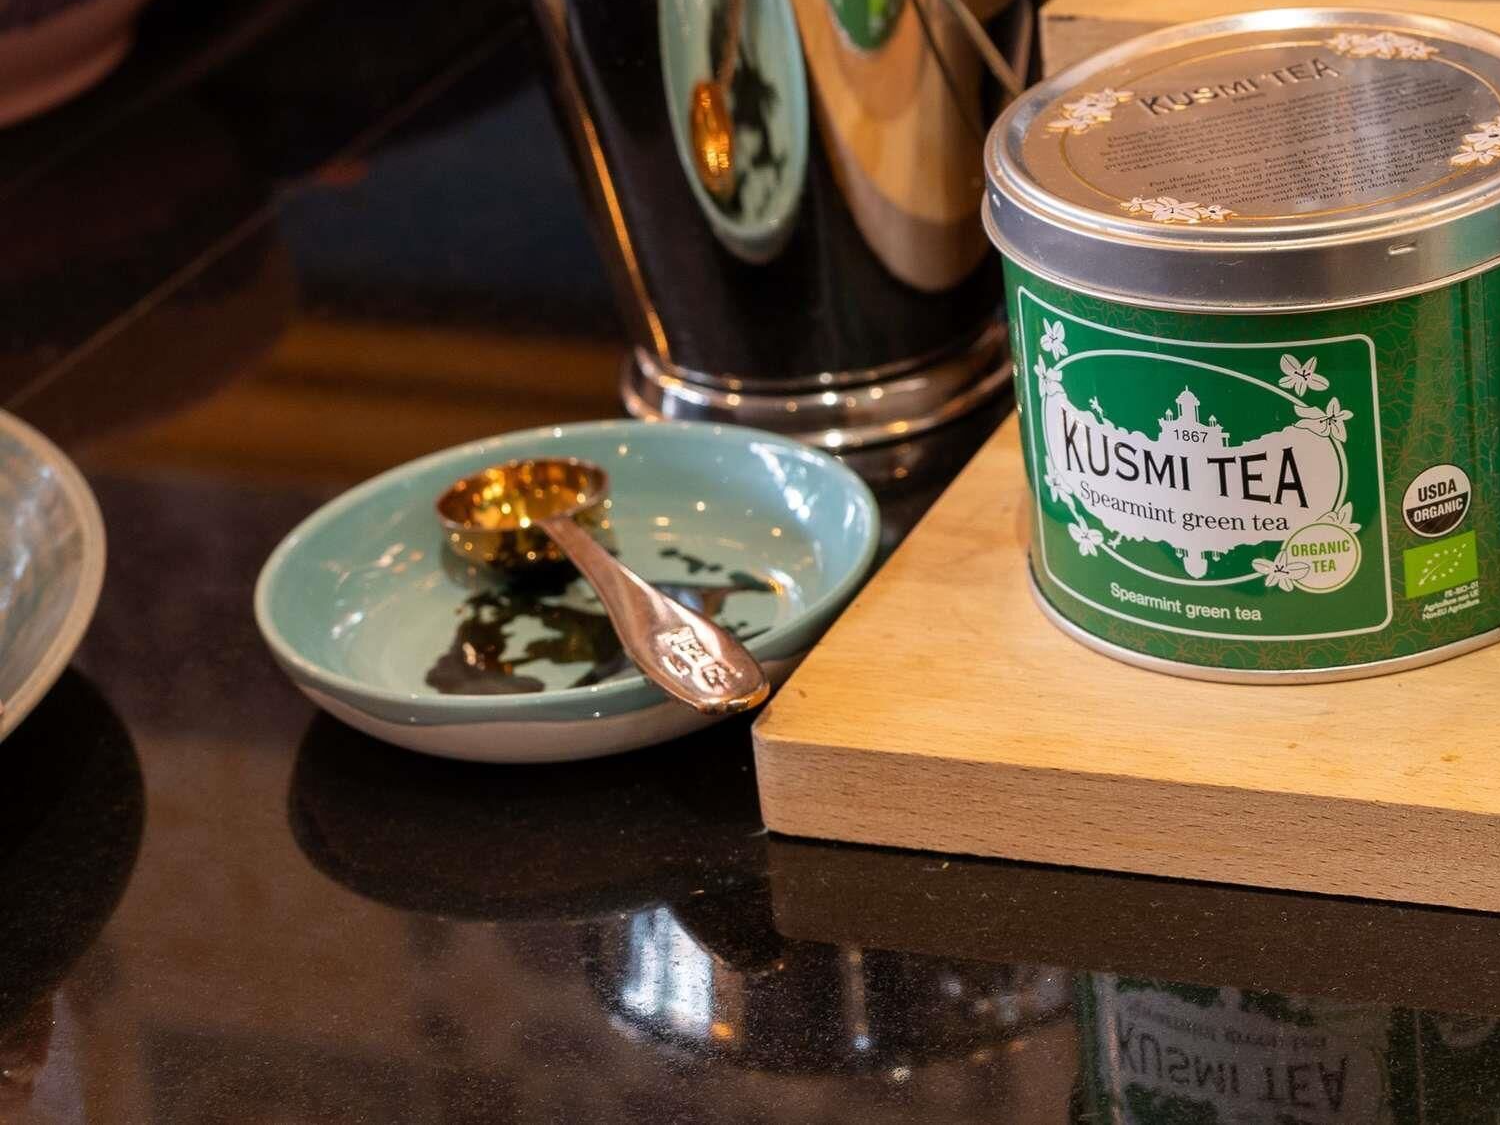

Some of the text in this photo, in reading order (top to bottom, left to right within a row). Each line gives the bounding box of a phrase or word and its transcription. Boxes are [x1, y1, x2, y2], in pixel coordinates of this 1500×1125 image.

[1137, 57, 1340, 115] KUSMI TEA
[1174, 429, 1208, 443] 1867
[1061, 409, 1309, 509] KUSMI TEA
[1418, 478, 1457, 503] USDA
[1080, 479, 1290, 532] Spearmint green tea
[1413, 498, 1463, 523] ORGANIC
[1290, 539, 1350, 557] ORGANIC
[1312, 559, 1336, 574] TEA
[1110, 581, 1263, 621] Spearmint green tea
